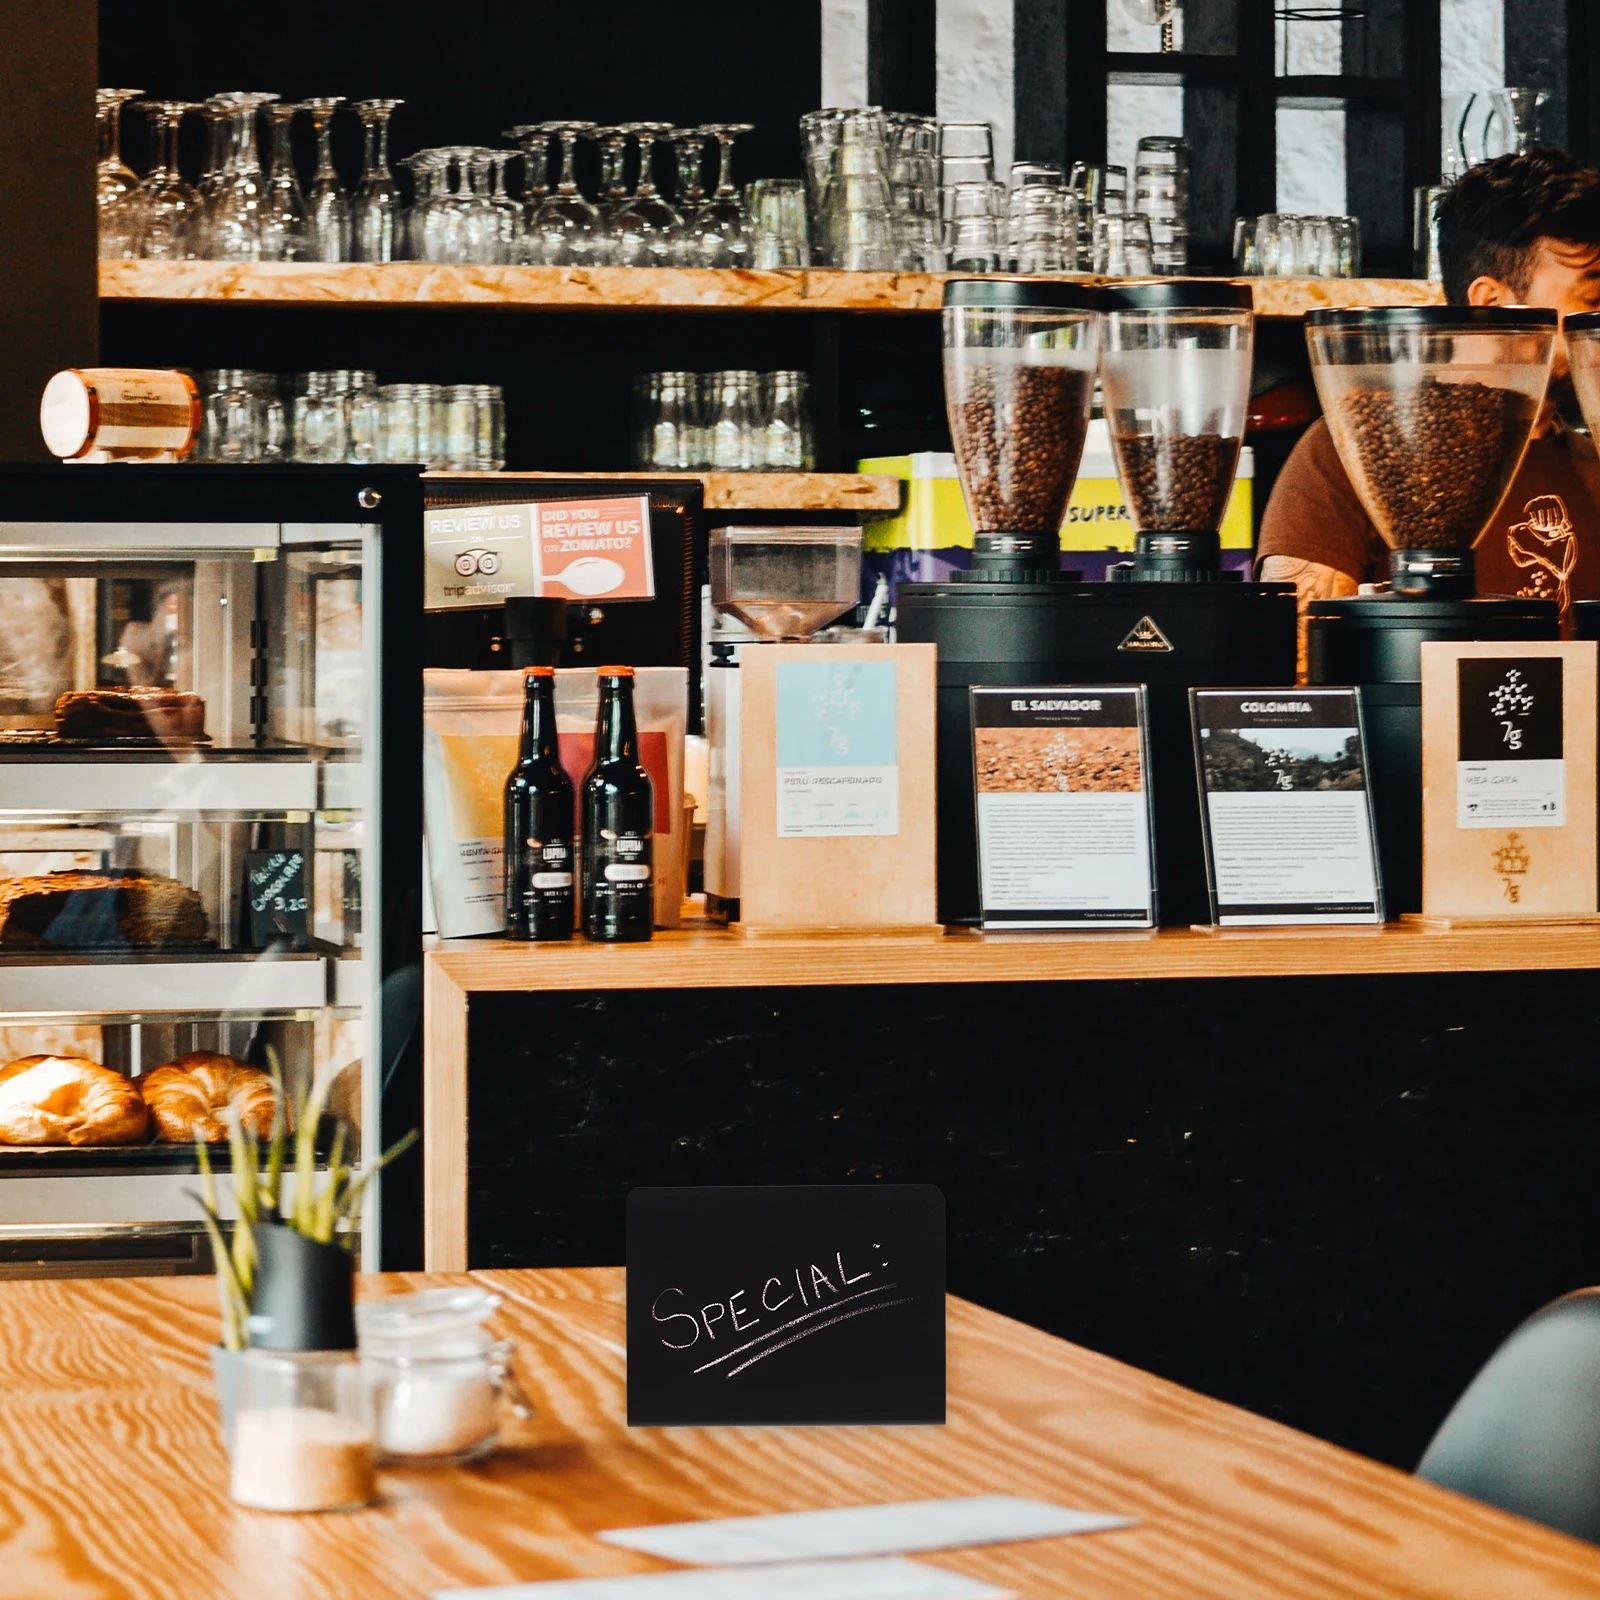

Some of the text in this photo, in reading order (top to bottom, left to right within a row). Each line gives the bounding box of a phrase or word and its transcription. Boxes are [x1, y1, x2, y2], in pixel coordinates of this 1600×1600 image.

[542, 507, 599, 522] DID YOU
[1067, 505, 1131, 523] SUPER
[430, 514, 522, 535] REVIEW US
[542, 519, 640, 538] REVIEW US
[560, 537, 632, 552] ZOMATO?
[443, 582, 514, 598] tripadvisor
[1011, 700, 1102, 711] EL SALVADOR
[1240, 702, 1313, 713] COLOMBIA
[1500, 721, 1523, 750] 7g
[1273, 769, 1294, 791] 7g
[1502, 878, 1521, 904] 7g
[652, 1243, 889, 1350] SPECIAL:
